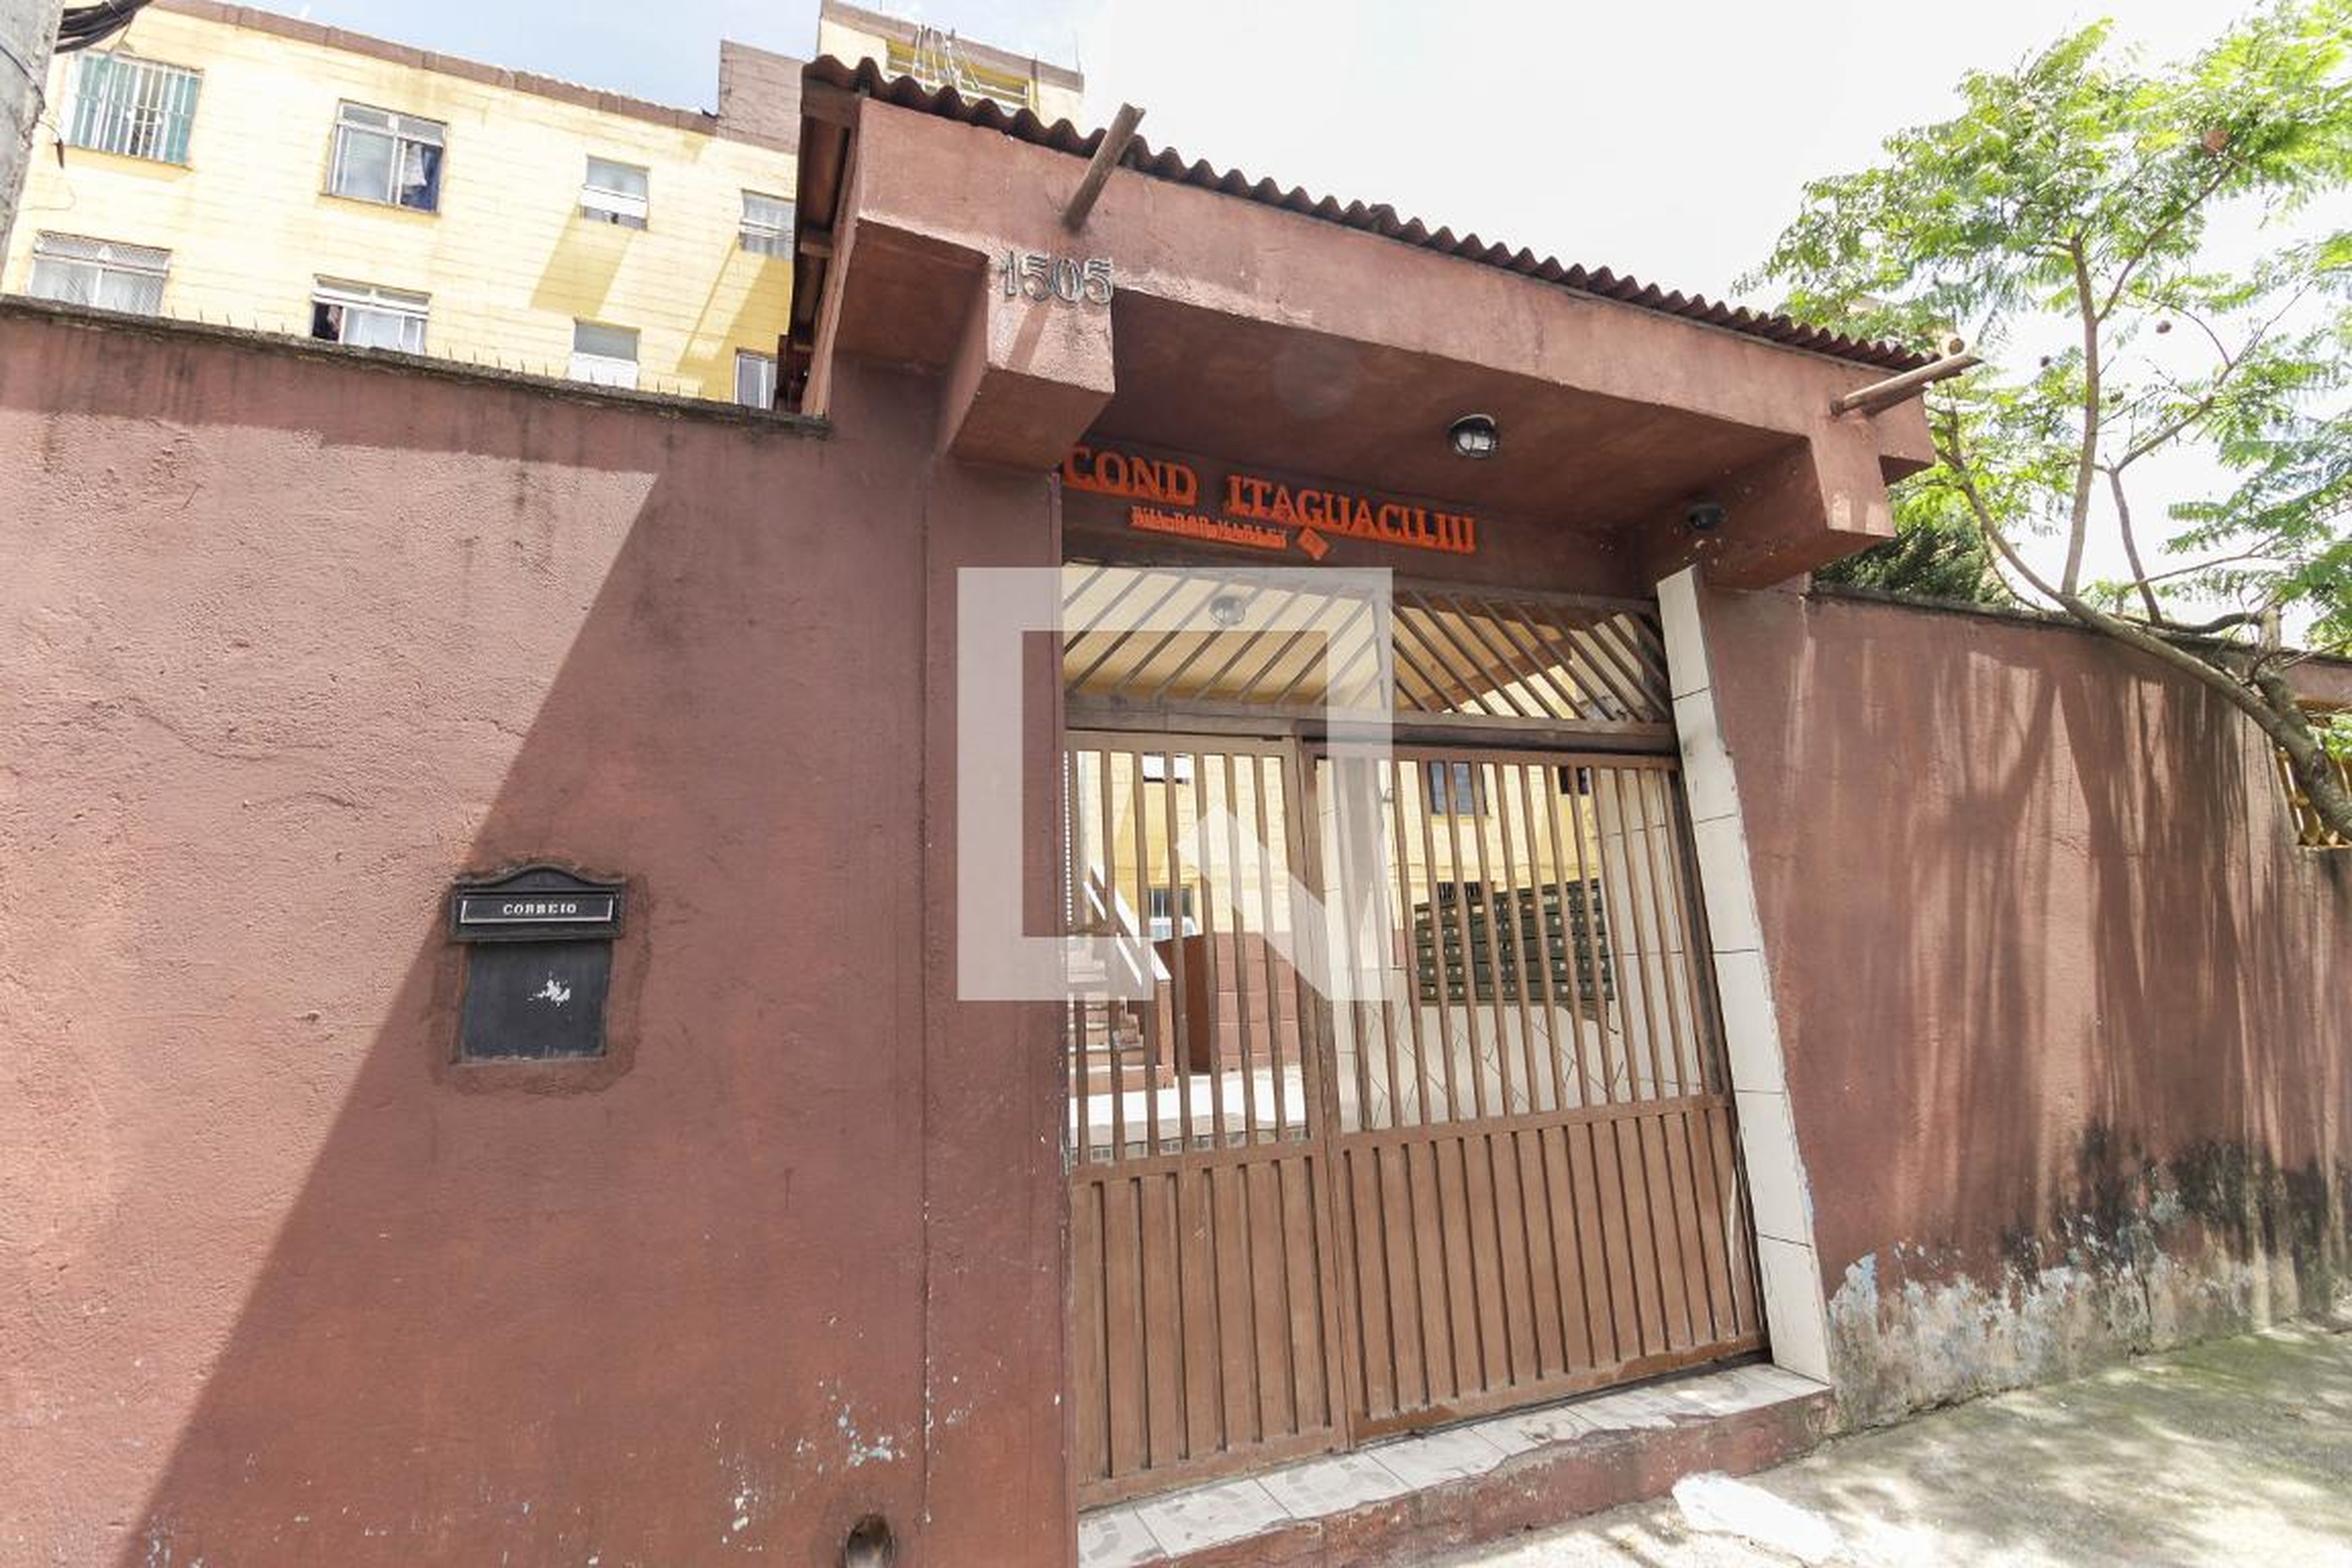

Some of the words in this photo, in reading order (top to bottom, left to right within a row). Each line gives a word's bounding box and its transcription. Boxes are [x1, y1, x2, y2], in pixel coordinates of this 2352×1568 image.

[1001, 251, 1114, 305] 1505
[1062, 445, 1197, 506] COND
[503, 903, 577, 916] CORREIO
